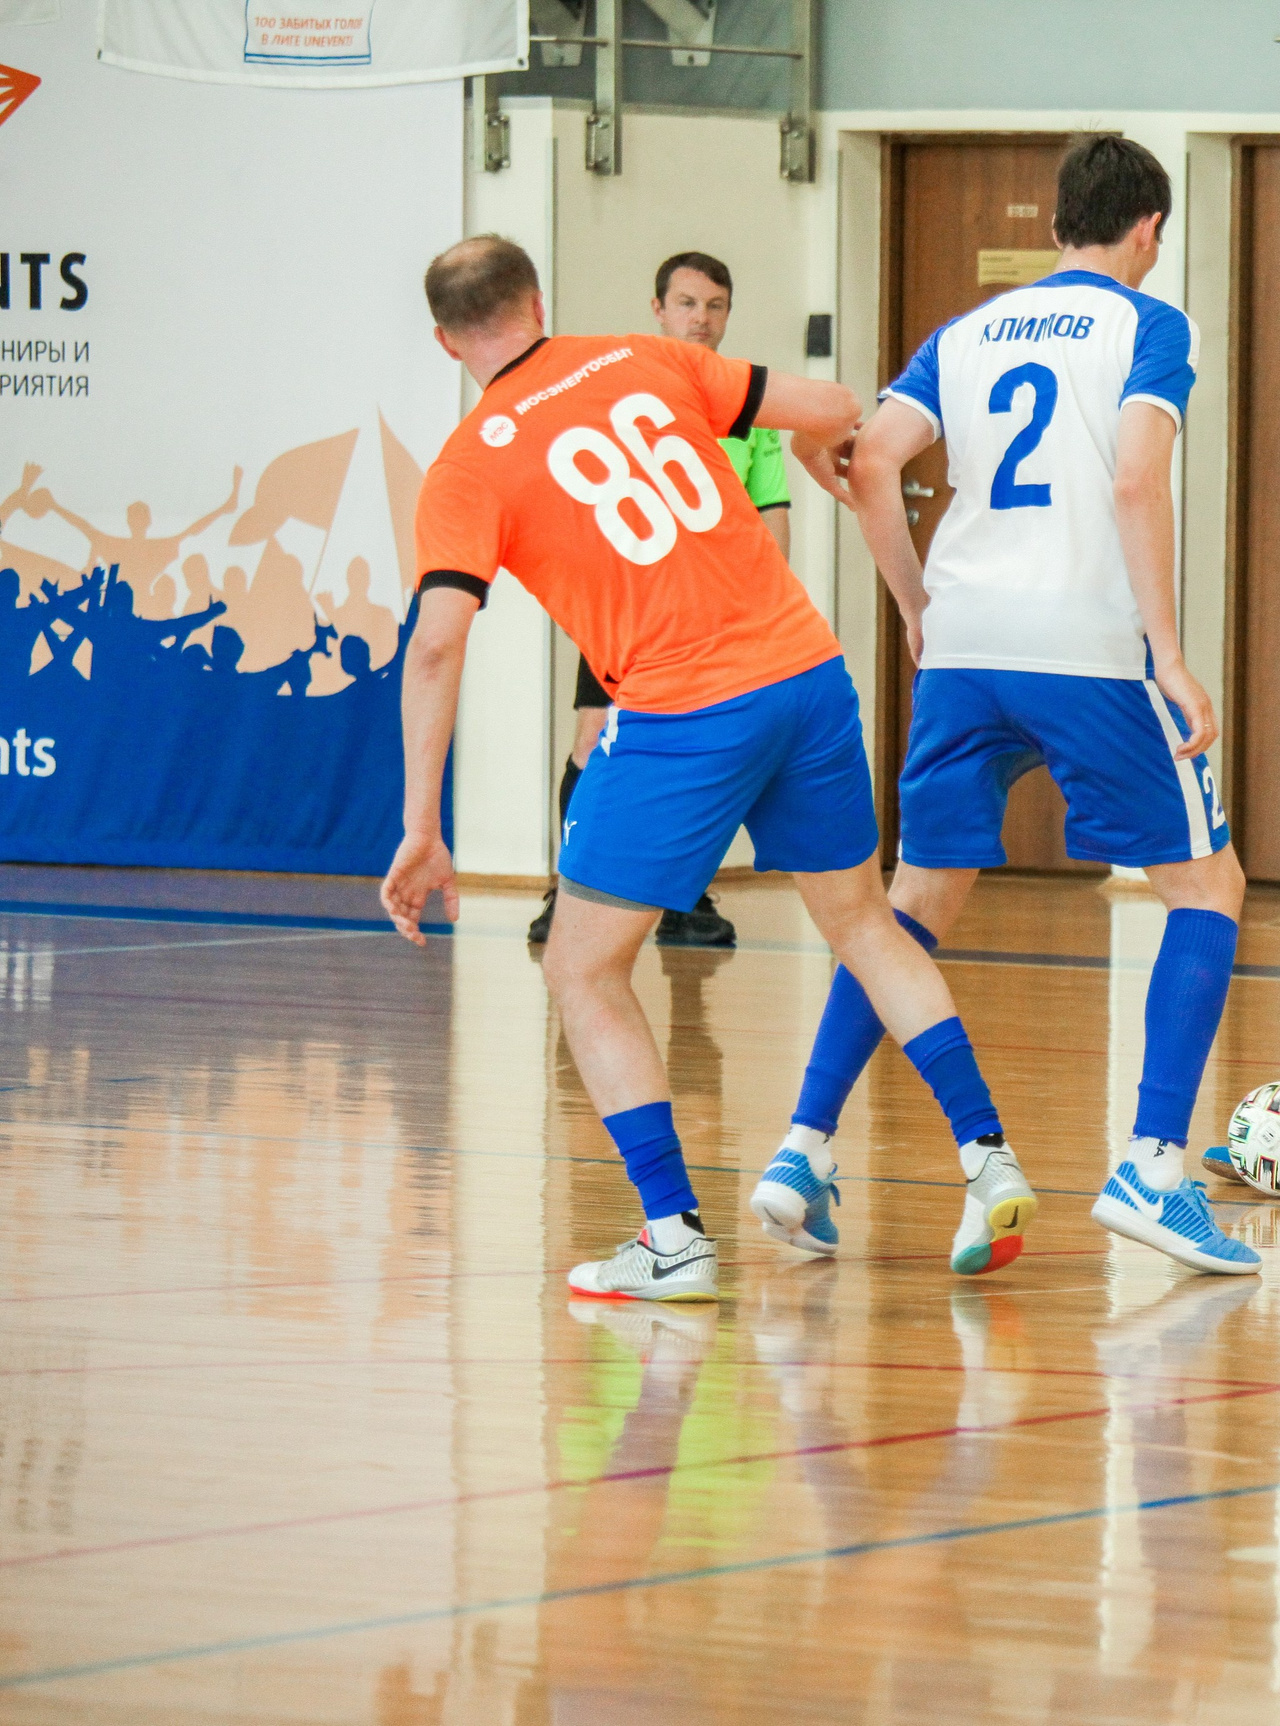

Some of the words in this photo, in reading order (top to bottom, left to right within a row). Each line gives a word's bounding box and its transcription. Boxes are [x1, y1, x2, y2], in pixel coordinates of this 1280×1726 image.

[261, 33, 269, 46] В
[279, 17, 331, 30] ЗАБИТЫХ
[0, 252, 89, 312] TS
[74, 341, 90, 363] И
[979, 313, 1095, 346] КЛИМОВ
[514, 347, 634, 415] МОСЭНЕРГОСБЫТ
[988, 361, 1058, 511] 2
[547, 393, 723, 565] 86
[1202, 766, 1226, 830] 2
